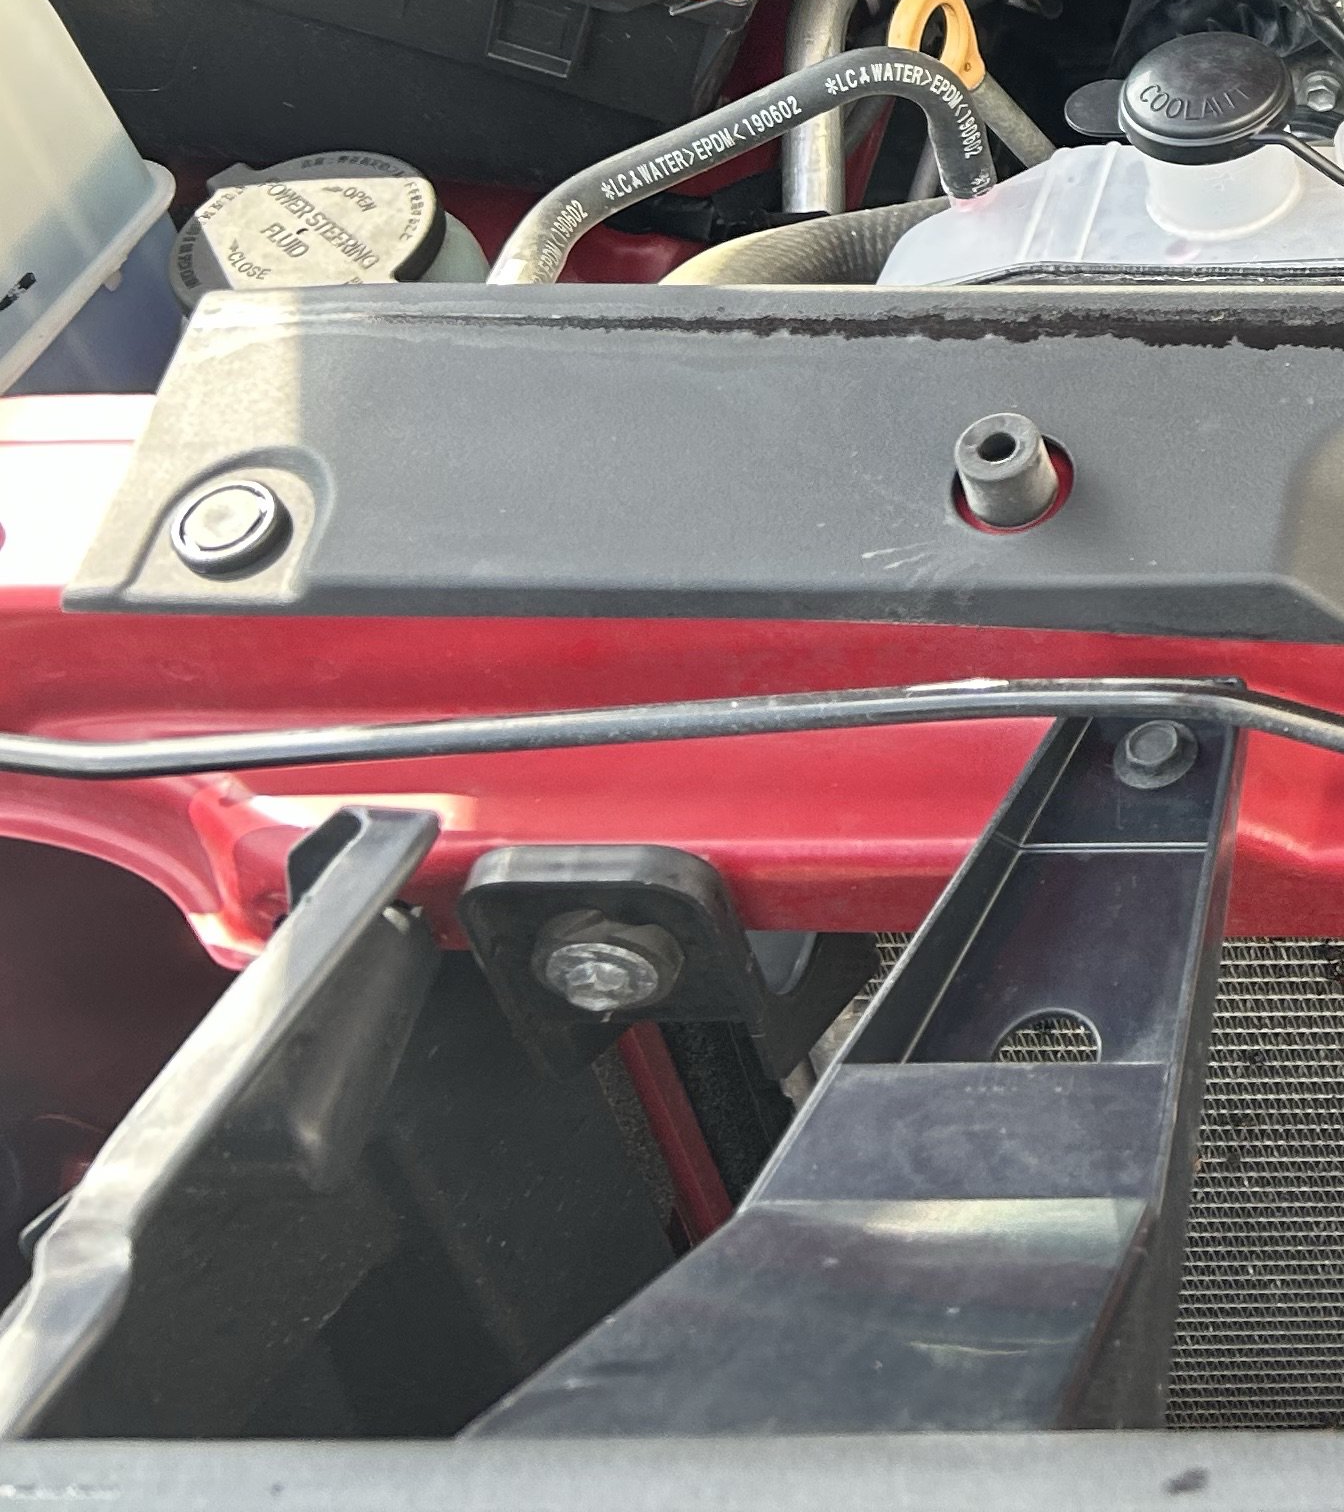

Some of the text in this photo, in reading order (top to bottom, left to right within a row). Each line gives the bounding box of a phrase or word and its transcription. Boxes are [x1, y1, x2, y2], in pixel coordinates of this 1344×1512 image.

[342, 186, 378, 213] OPEN
[259, 178, 314, 220] POWER
[305, 211, 380, 271] STEERING
[259, 221, 310, 259] FLUID
[226, 250, 272, 281] CLOSE
